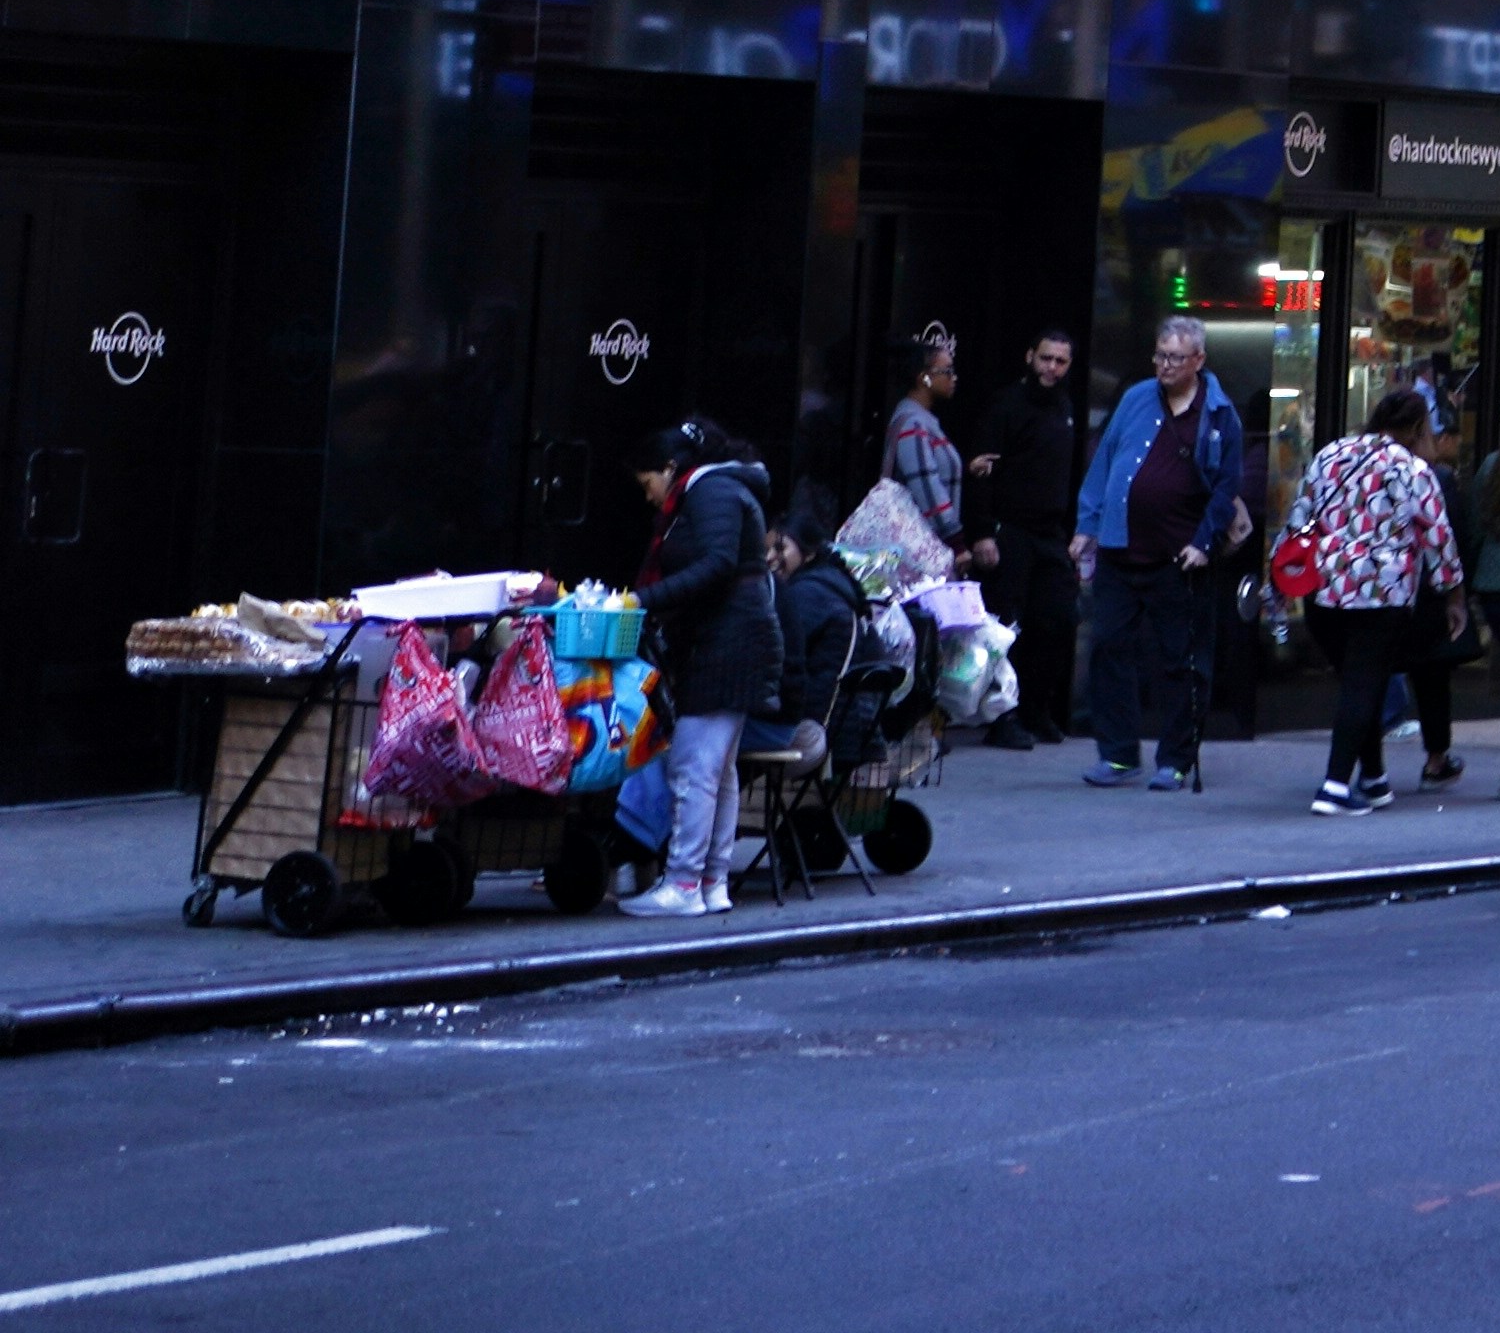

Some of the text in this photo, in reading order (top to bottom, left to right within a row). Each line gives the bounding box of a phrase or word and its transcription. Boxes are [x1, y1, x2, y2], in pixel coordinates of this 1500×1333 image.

[90, 327, 166, 358] Hard Rock
[589, 333, 651, 360] Hard Rock
